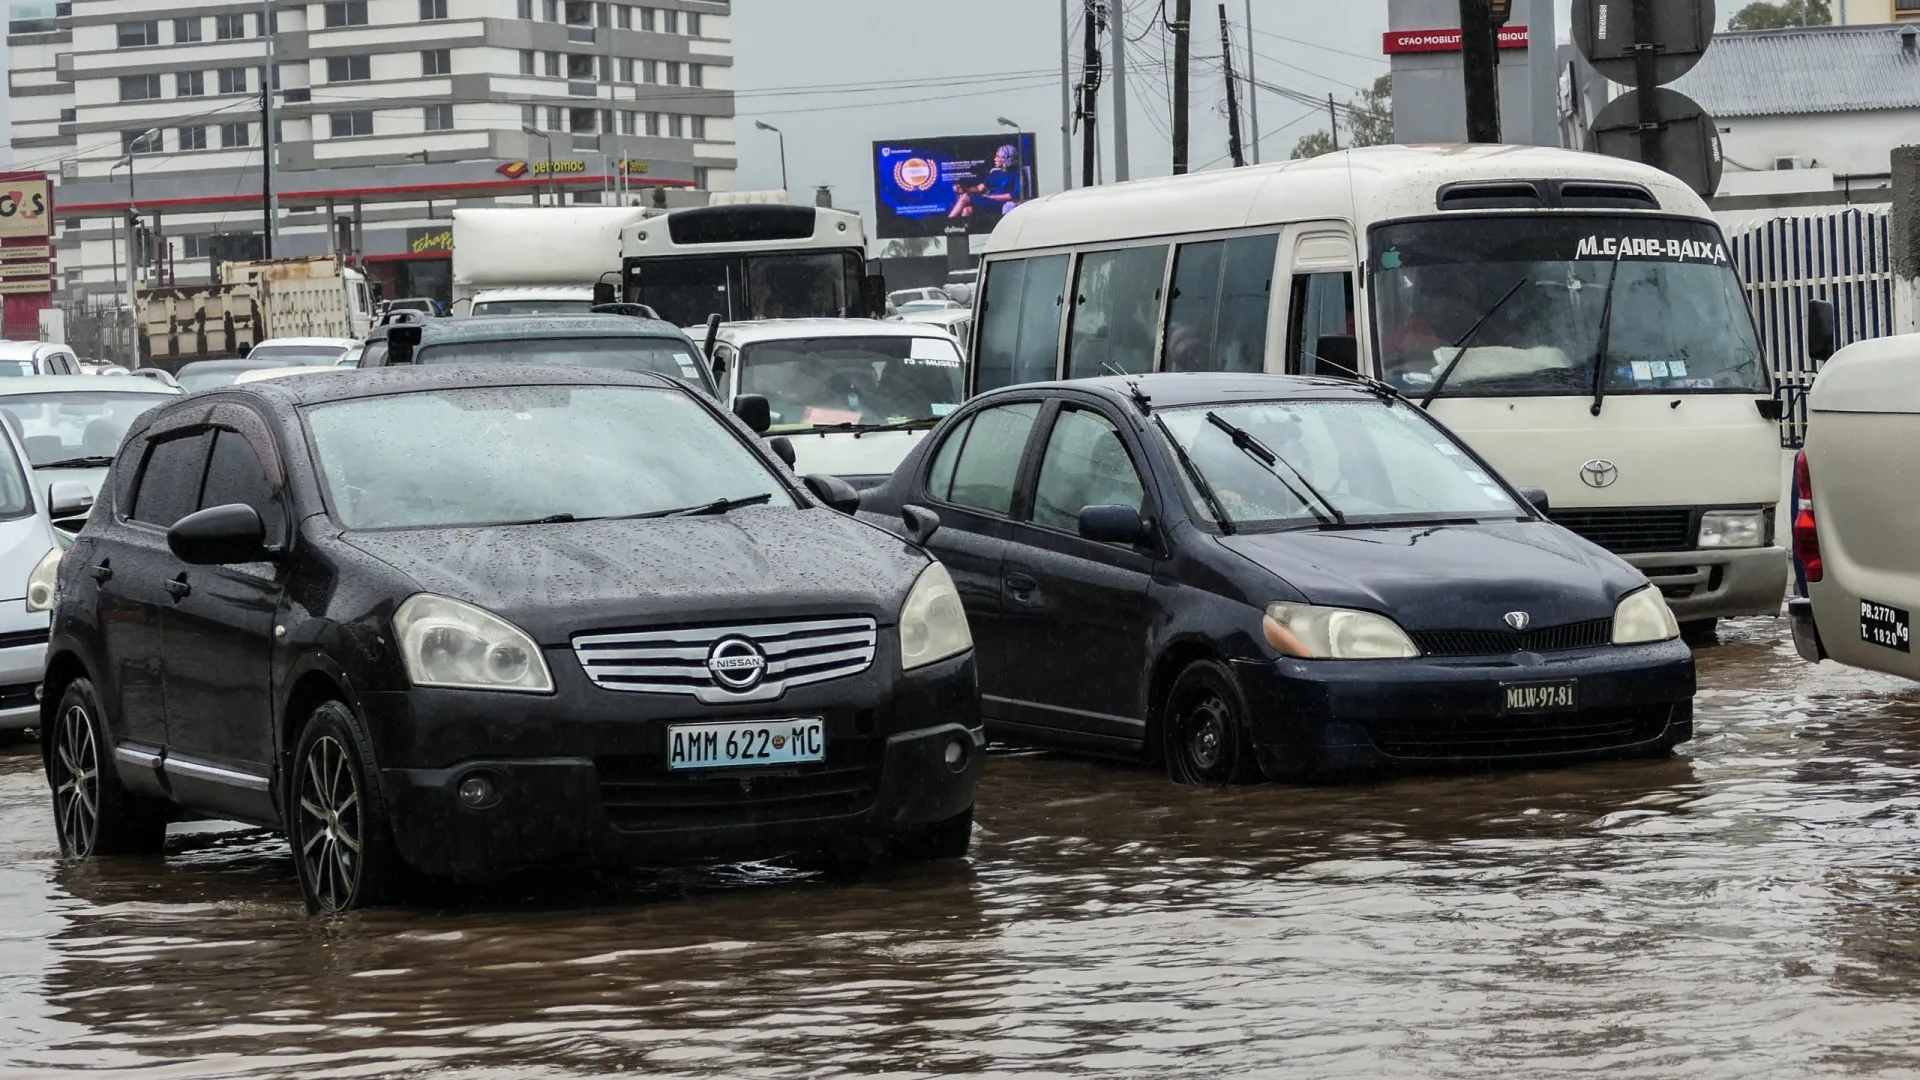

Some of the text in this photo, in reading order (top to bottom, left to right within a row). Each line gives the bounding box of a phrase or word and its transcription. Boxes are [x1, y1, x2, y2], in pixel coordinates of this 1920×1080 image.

[1398, 36, 1422, 46] CFAO
[1424, 35, 1461, 44] MOBILIT
[0, 191, 44, 219] G4S
[1861, 602, 1895, 623] PB.2770
[1861, 622, 1908, 646] T. 1820 Kg
[716, 657, 760, 668] NISSAN
[672, 725, 821, 762] AMM 622 MC
